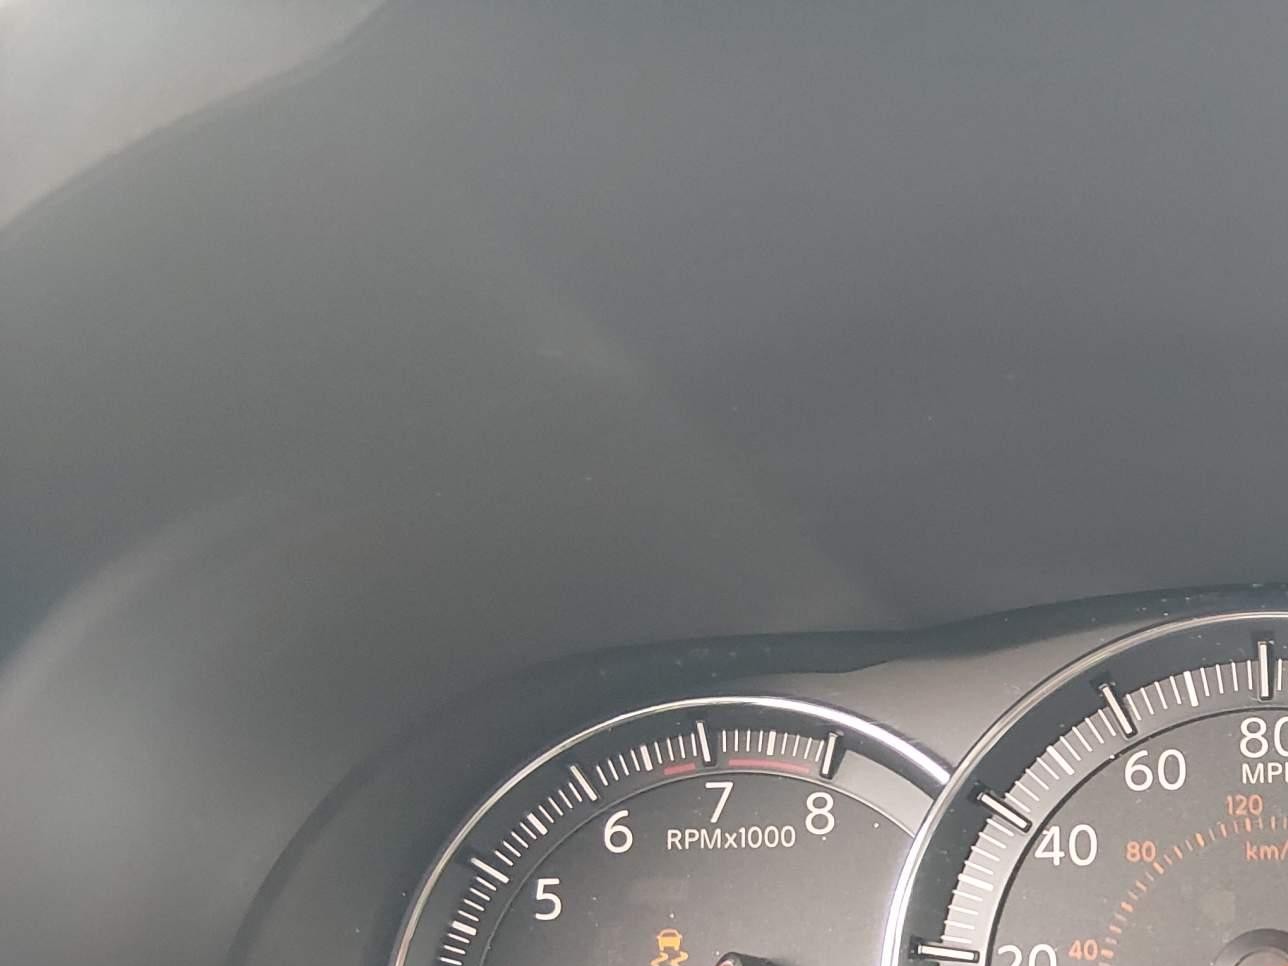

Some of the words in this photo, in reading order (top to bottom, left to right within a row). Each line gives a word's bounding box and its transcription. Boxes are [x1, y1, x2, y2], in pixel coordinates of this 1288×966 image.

[1124, 750, 1187, 791] 60
[705, 781, 733, 823] 7
[804, 792, 834, 834] 8
[1226, 796, 1263, 816] 120
[603, 810, 633, 853] 6
[666, 825, 796, 850] RPMx1000
[1035, 825, 1098, 866] 40
[1126, 841, 1157, 863] 80
[535, 878, 562, 921] 5
[1069, 940, 1098, 961] 40
